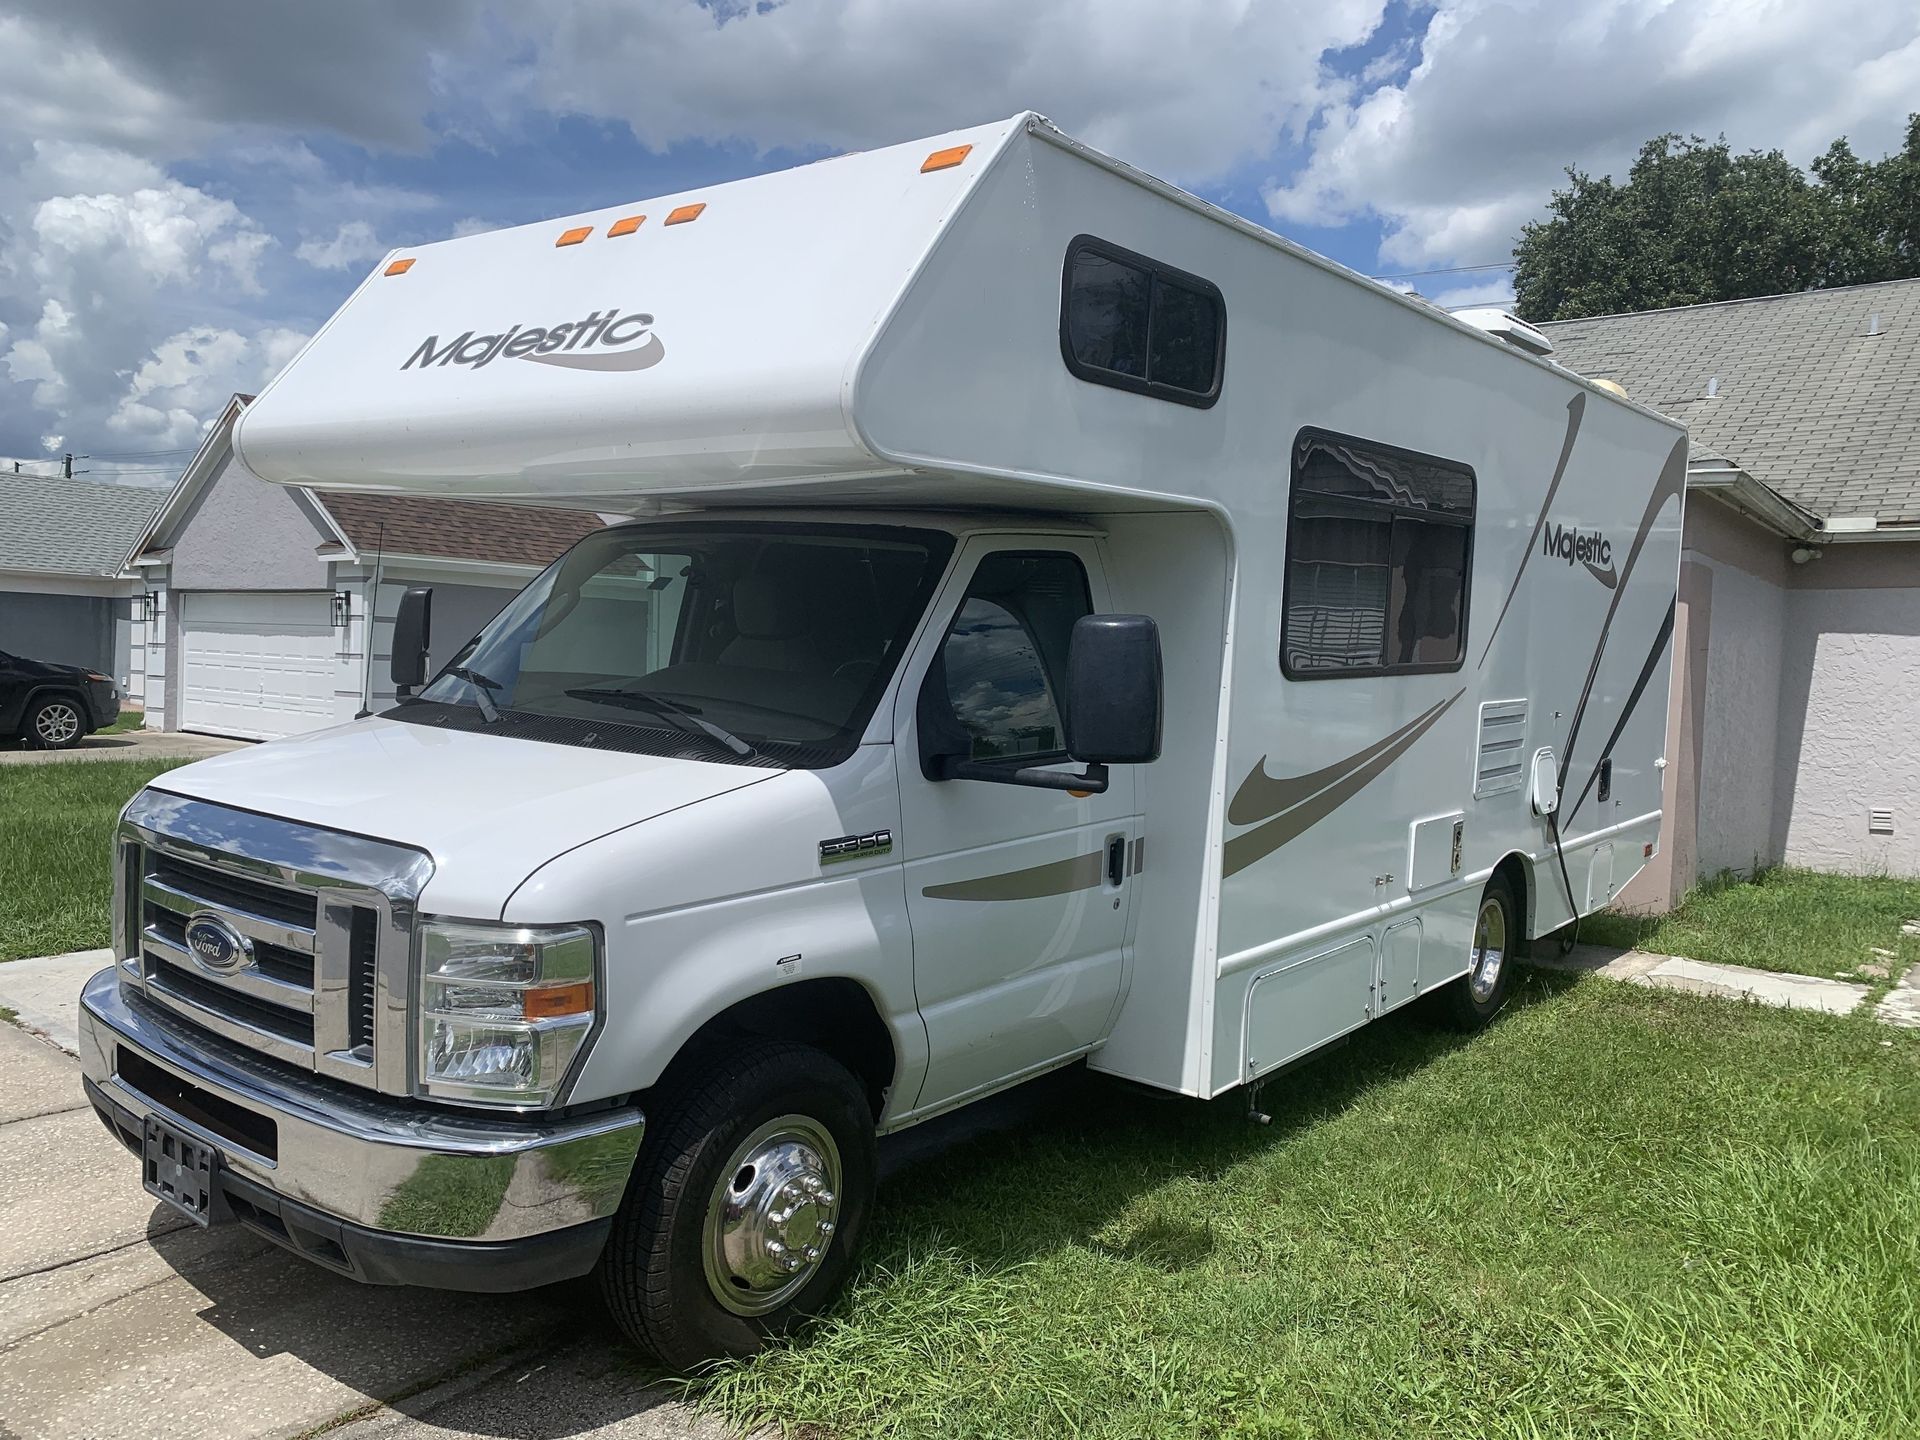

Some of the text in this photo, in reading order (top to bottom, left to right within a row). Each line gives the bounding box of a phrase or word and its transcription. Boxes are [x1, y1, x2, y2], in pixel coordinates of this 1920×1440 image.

[400, 308, 654, 370] Majestic
[1543, 521, 1611, 567] Majestic
[874, 847, 891, 855] DUTY
[194, 931, 222, 958] Ford
